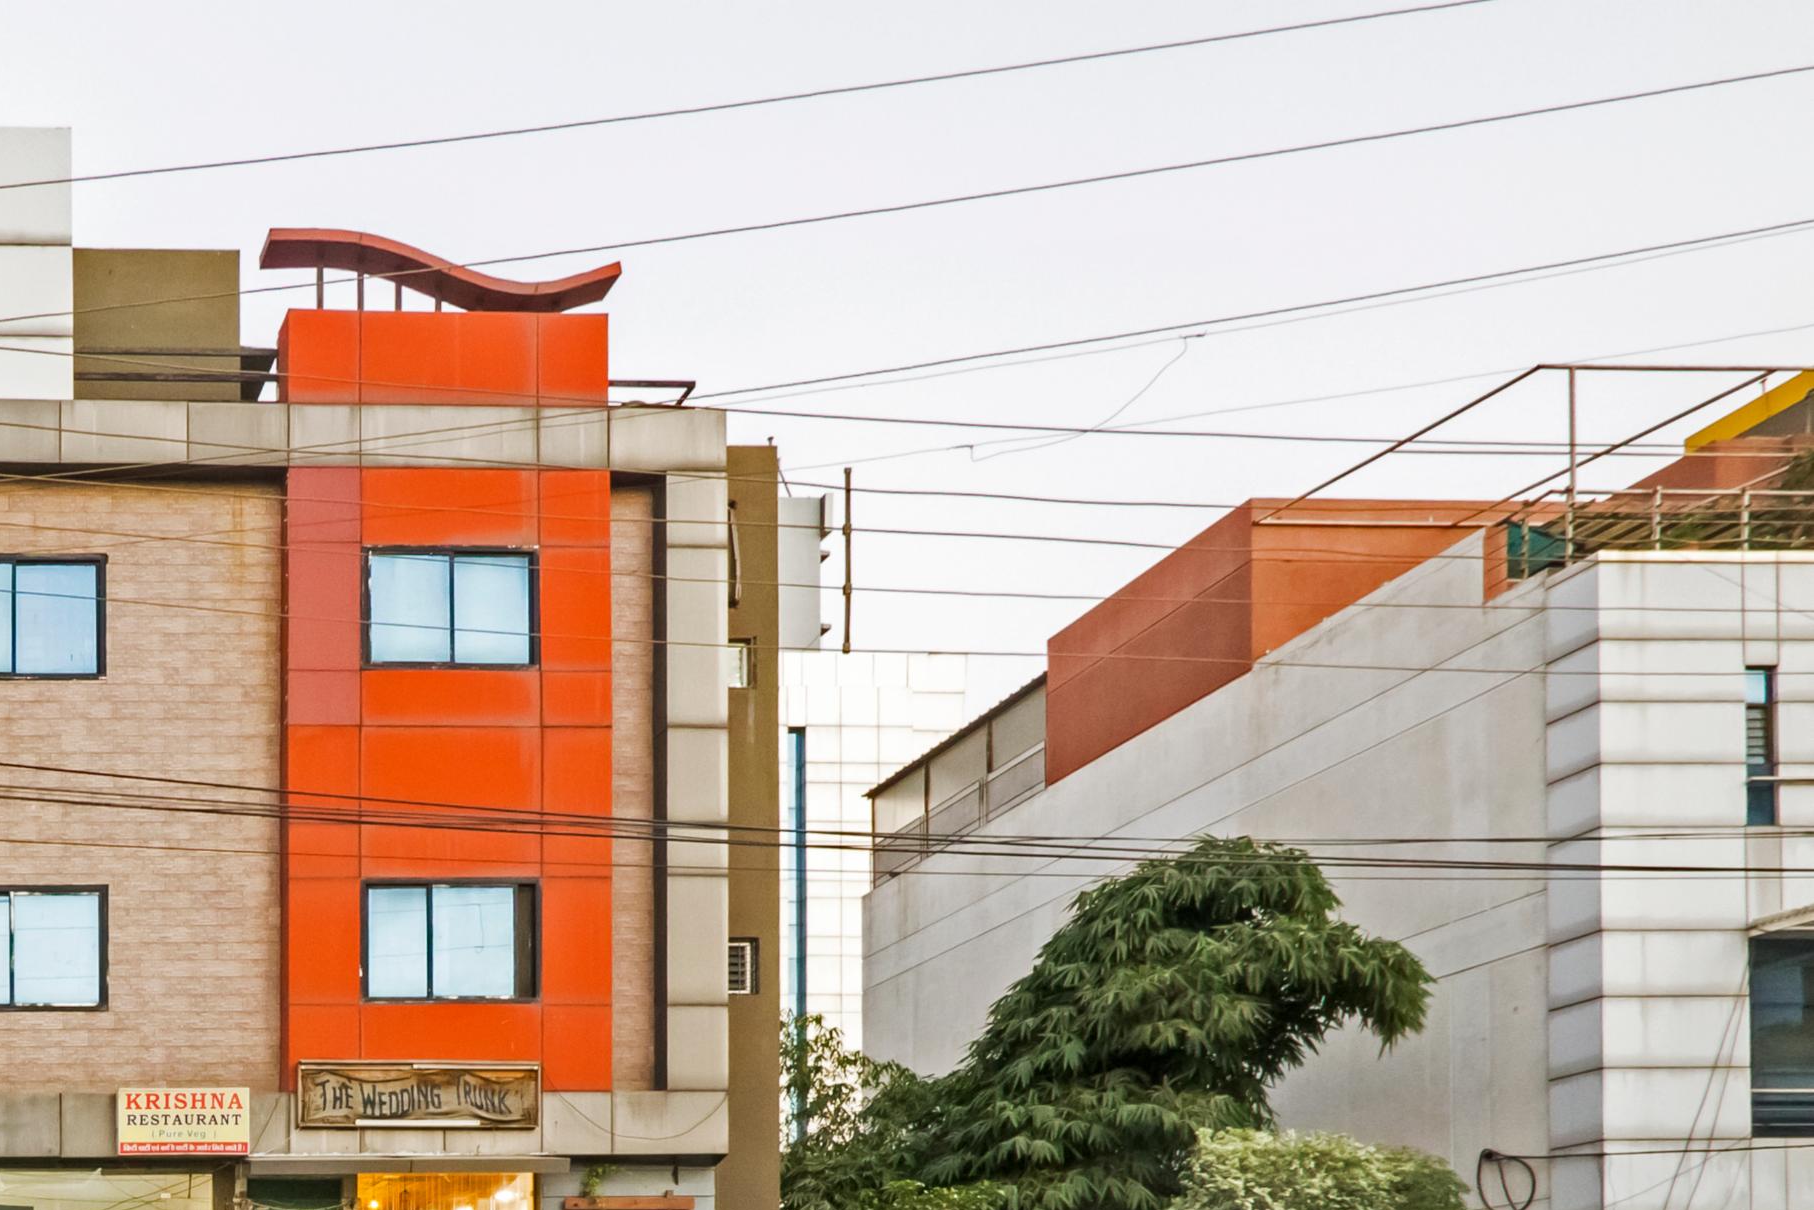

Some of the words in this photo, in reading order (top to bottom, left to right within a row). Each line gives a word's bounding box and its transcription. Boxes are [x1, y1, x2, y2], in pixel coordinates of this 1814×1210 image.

[125, 1092, 244, 1110] KRISHNA
[316, 1078, 354, 1112] THE
[359, 1082, 442, 1118] WEDDING
[454, 1078, 513, 1115] TRUNK
[127, 1113, 242, 1126] RESTAURANT
